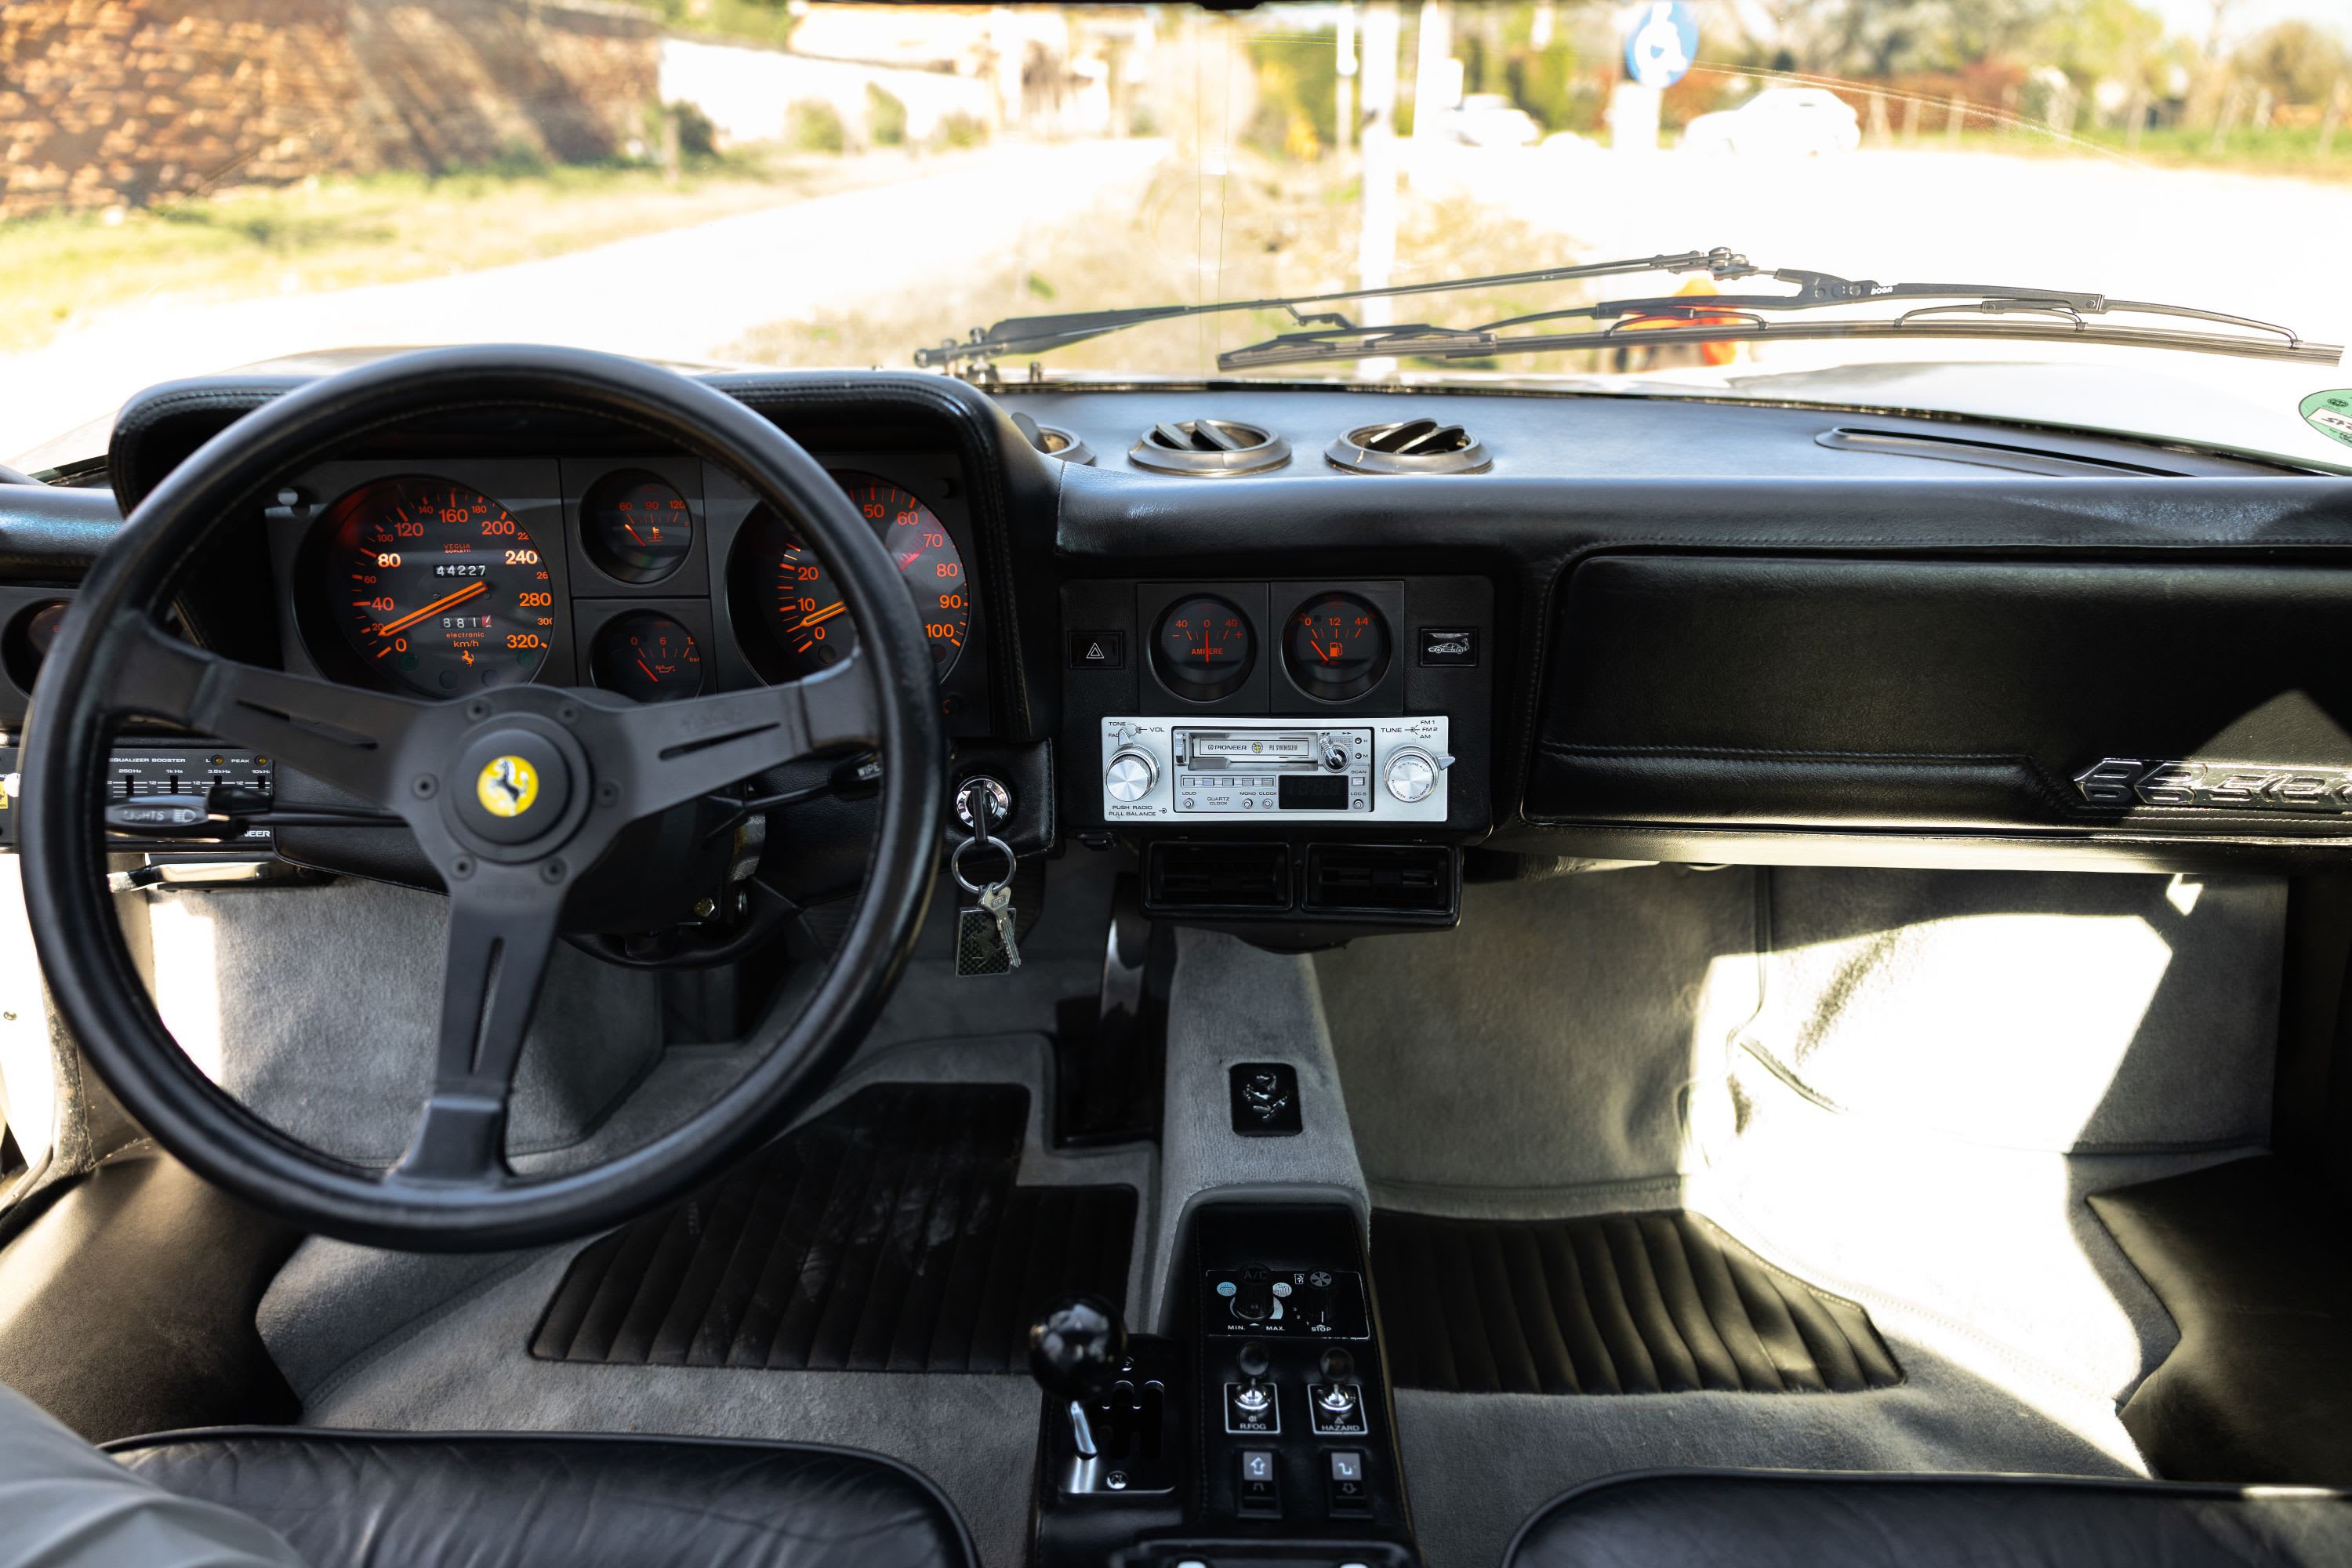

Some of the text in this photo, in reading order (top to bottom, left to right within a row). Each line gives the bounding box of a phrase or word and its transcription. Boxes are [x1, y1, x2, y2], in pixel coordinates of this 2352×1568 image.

[419, 506, 433, 514] 140
[646, 502, 659, 510] 90
[670, 500, 685, 510] 120
[864, 504, 884, 517] 50
[439, 510, 468, 523] 160
[897, 512, 918, 526] 60
[395, 523, 423, 536] 120
[481, 521, 515, 535] 200
[924, 534, 942, 548] 70
[378, 554, 401, 568] 80
[505, 550, 538, 564] 240
[437, 565, 485, 576] 44227
[798, 567, 818, 580] 20
[937, 564, 957, 577] 80
[372, 597, 394, 612] 40
[519, 593, 551, 607] 280
[798, 599, 815, 611] 10
[940, 595, 960, 608] 90
[815, 627, 826, 640] 0
[925, 624, 954, 637] 100
[395, 639, 407, 652] 0
[506, 635, 539, 648] 320
[659, 637, 666, 645] 6
[1243, 1269, 1268, 1280] A/C
